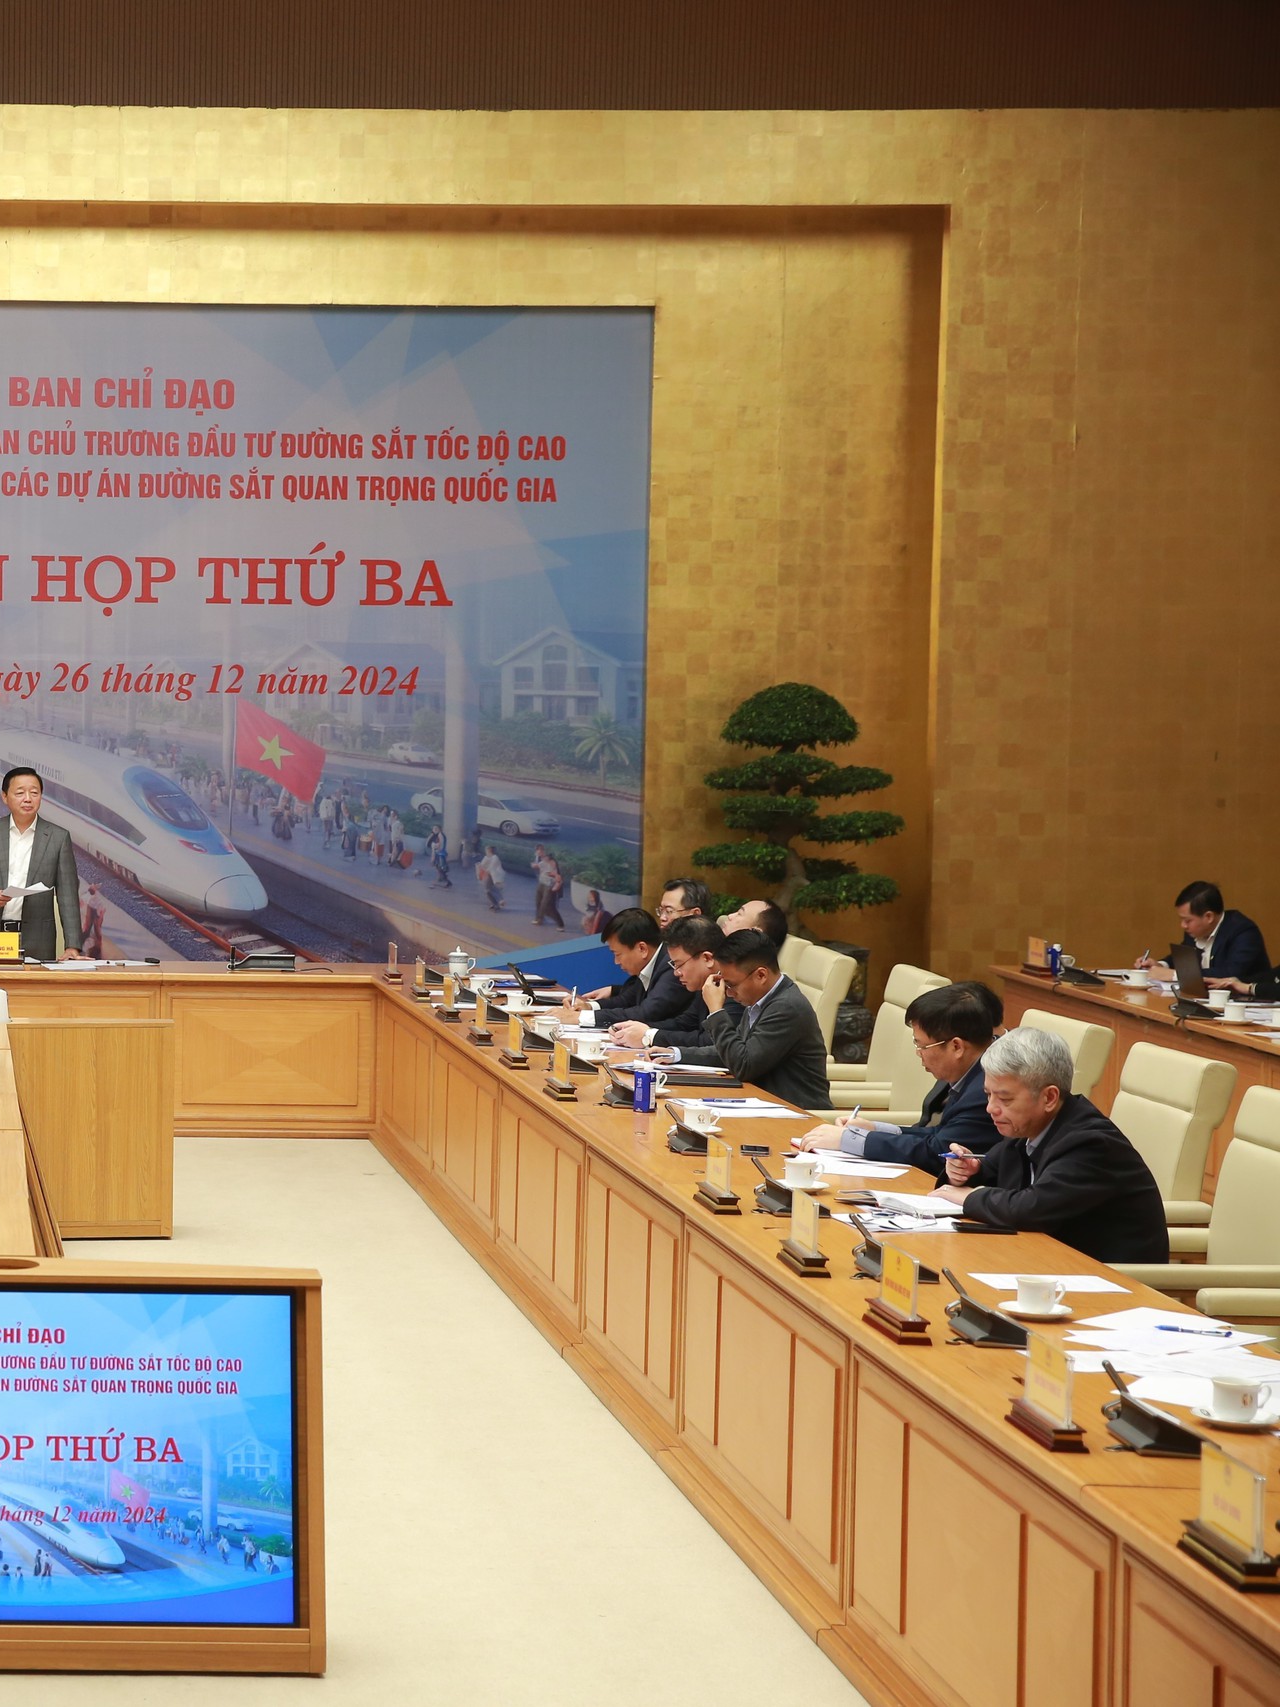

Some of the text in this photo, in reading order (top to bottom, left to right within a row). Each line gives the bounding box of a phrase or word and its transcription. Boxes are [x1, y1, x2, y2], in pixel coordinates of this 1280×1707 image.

[8, 366, 236, 416] BAN CHỈ ĐẠO
[27, 420, 76, 455] CHỦ
[83, 428, 180, 457] TRƯƠNG
[187, 424, 237, 458] ĐẦU
[243, 430, 276, 458] TƯ
[280, 427, 364, 460] ĐƯỜNG
[371, 426, 417, 460] SẮT
[424, 426, 470, 460] TỐC
[477, 430, 510, 466] ĐỘ
[517, 435, 567, 462] CAO
[0, 466, 49, 497] CÁC
[56, 470, 93, 503] DỰ
[96, 468, 131, 498] ÁN
[138, 467, 221, 499] ĐƯỜNG
[229, 466, 275, 500] SẮT
[282, 475, 349, 503] QUAN
[356, 475, 436, 507] TRỌNG
[443, 468, 509, 504] QUỐC
[516, 477, 558, 503] GIA
[31, 554, 177, 617] HỌP
[198, 541, 345, 607] THỨ
[359, 558, 454, 607] BA
[50, 662, 90, 694] 26
[100, 663, 197, 702] tháng
[208, 664, 246, 696] 12
[257, 668, 329, 696] năm
[337, 665, 420, 697] 2024
[28, 1328, 66, 1347] ĐẠO
[71, 1356, 88, 1370] TƯ
[90, 1354, 134, 1371] ĐƯỜNG
[138, 1353, 162, 1371] SẮT
[167, 1353, 190, 1371] TỐC
[195, 1356, 212, 1374] ĐỘ
[217, 1358, 242, 1372] CAO
[14, 1375, 58, 1392] ĐƯỜNG
[63, 1374, 87, 1392] SẮT
[91, 1380, 127, 1394] QUAN
[131, 1380, 173, 1396] TRỌNG
[178, 1376, 212, 1395] QUỐC
[216, 1381, 238, 1394] GIA
[46, 1426, 126, 1463] THỨ
[134, 1436, 183, 1463] BA
[51, 1506, 72, 1523] 12
[78, 1508, 117, 1523] năm
[122, 1506, 167, 1524] 2024
